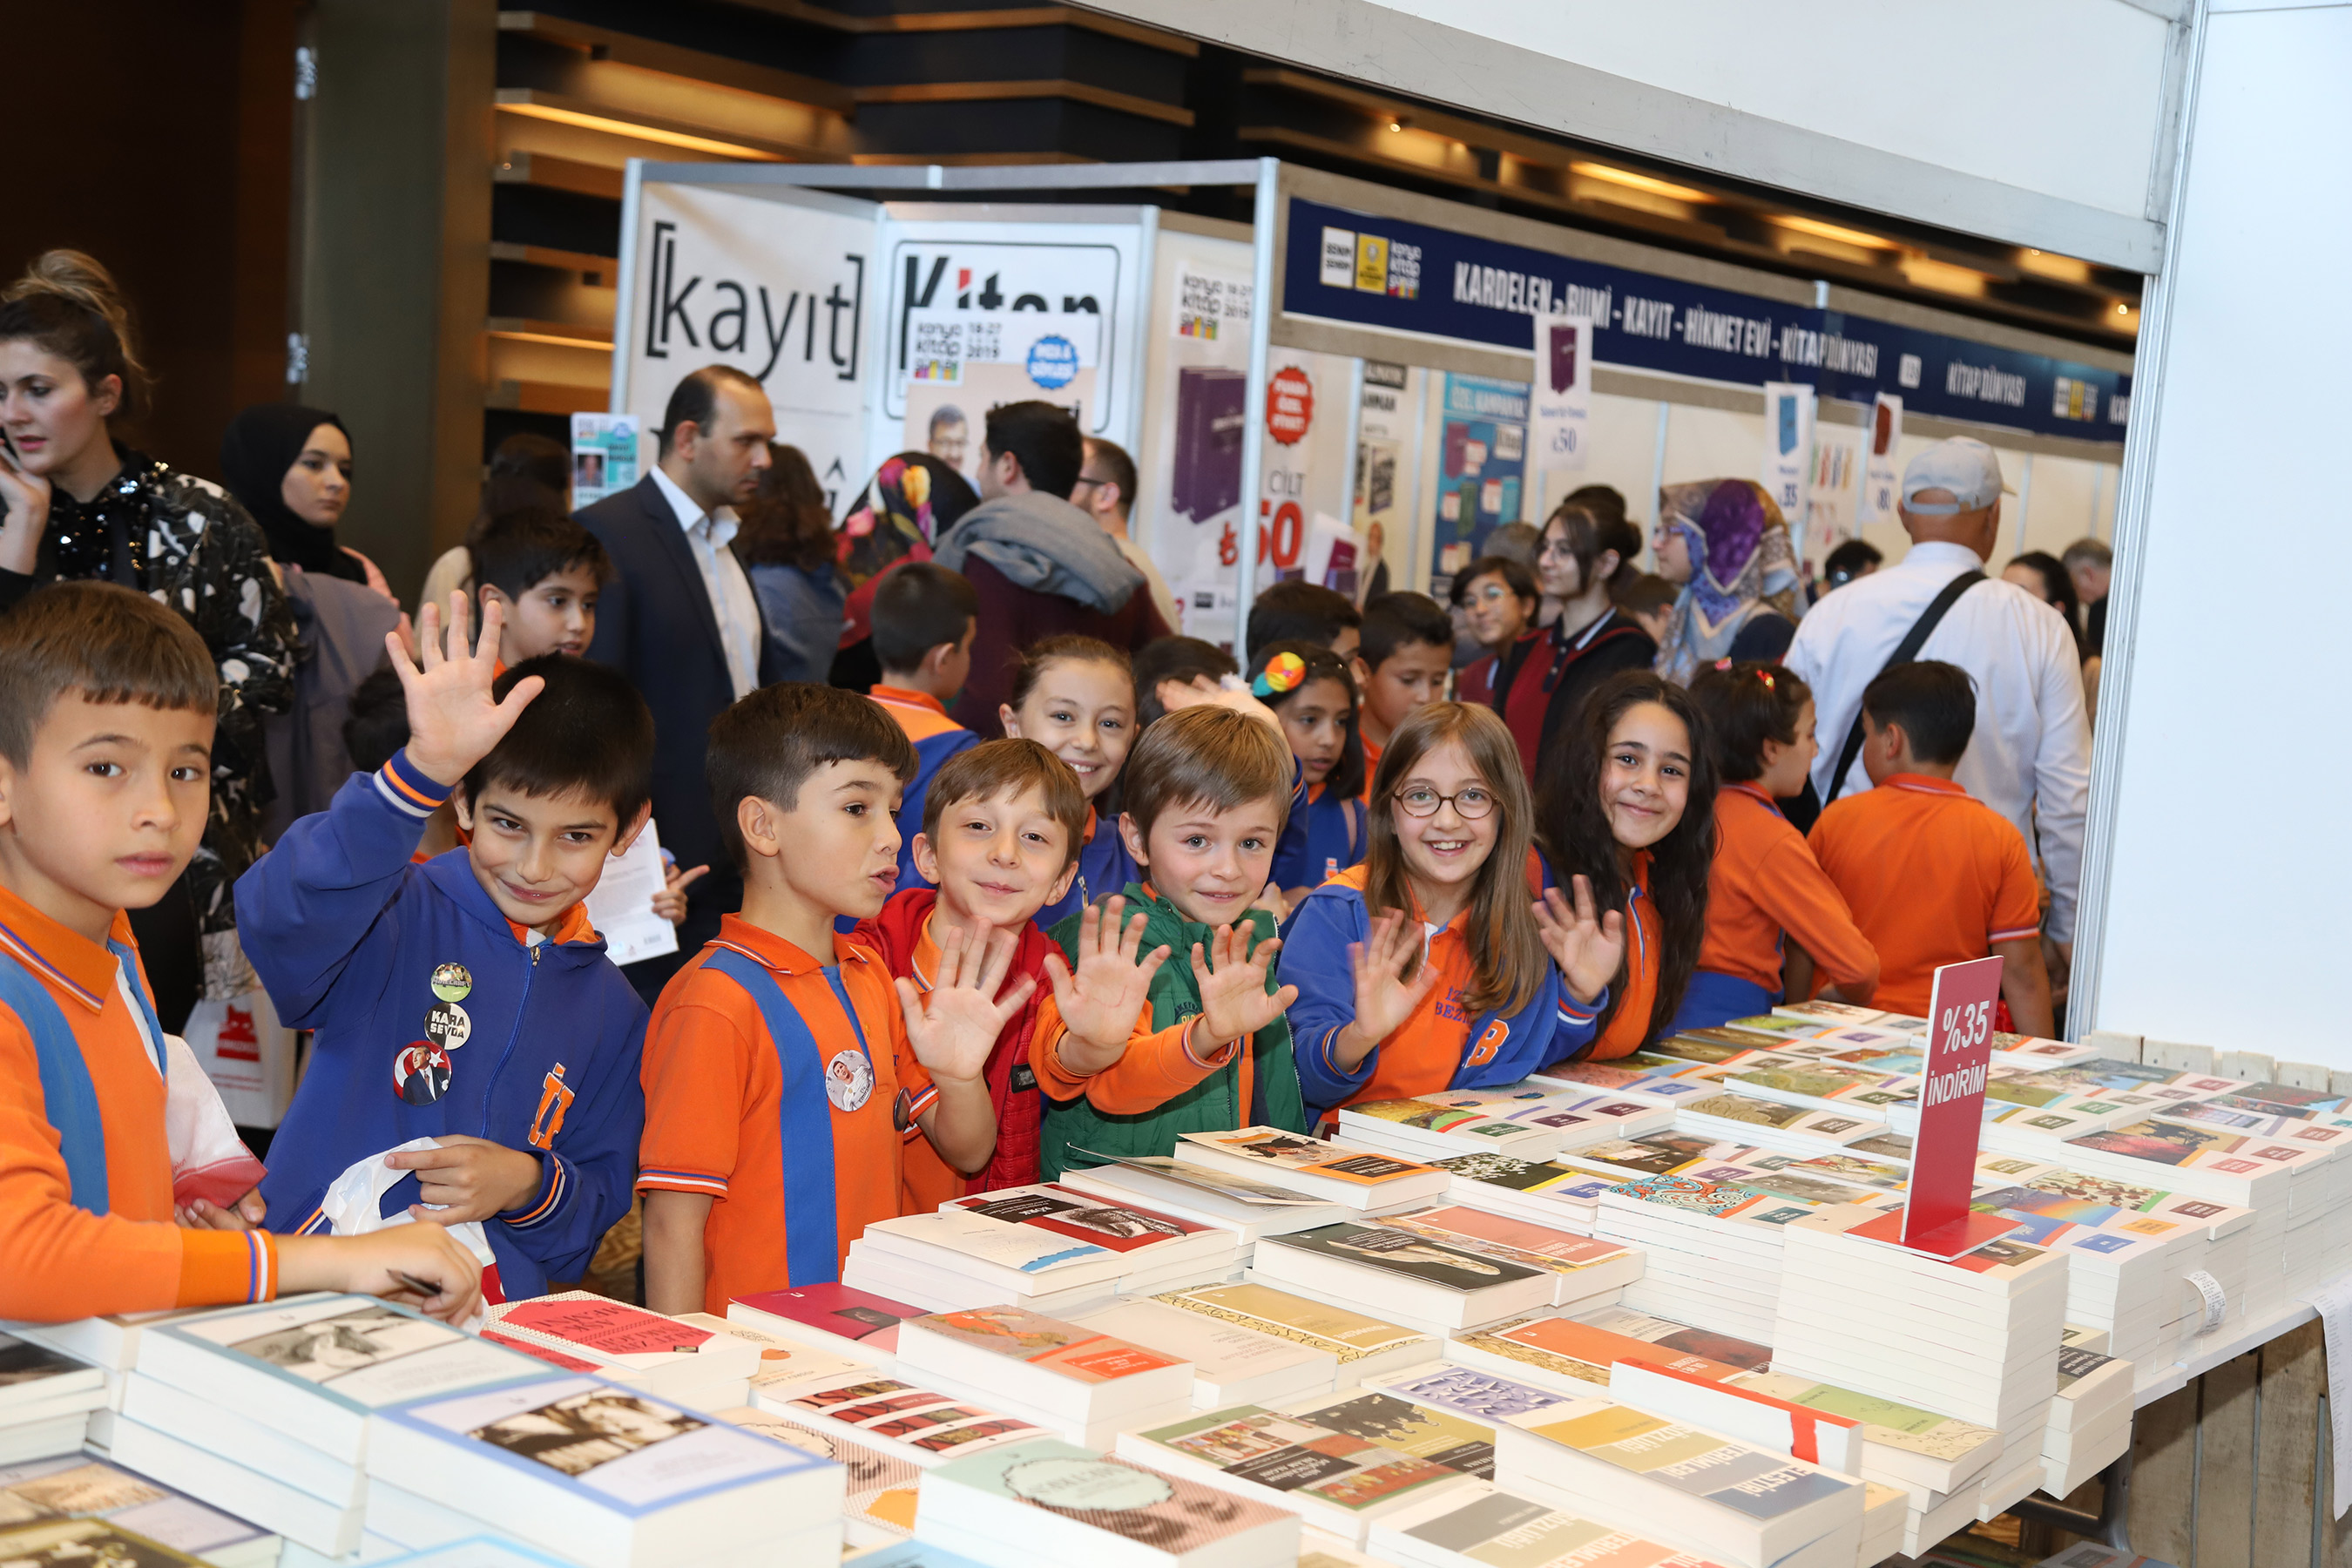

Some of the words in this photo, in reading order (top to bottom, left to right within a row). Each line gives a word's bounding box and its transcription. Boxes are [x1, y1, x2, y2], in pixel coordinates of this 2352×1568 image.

[1453, 260, 1552, 315] KARDELEN
[1623, 294, 1675, 341] KAYIT
[1268, 469, 1305, 495] CİLT
[429, 1023, 465, 1039] SEVDA
[431, 1010, 466, 1028] KARA
[1943, 1000, 1990, 1056] %35
[1926, 1058, 1987, 1108] İNDİRİM
[1612, 1425, 1690, 1456] SÖZLÜĞÜ
[1659, 1443, 1750, 1480] TERİMLERİ
[1733, 1466, 1809, 1497] ELEŞTİRİ
